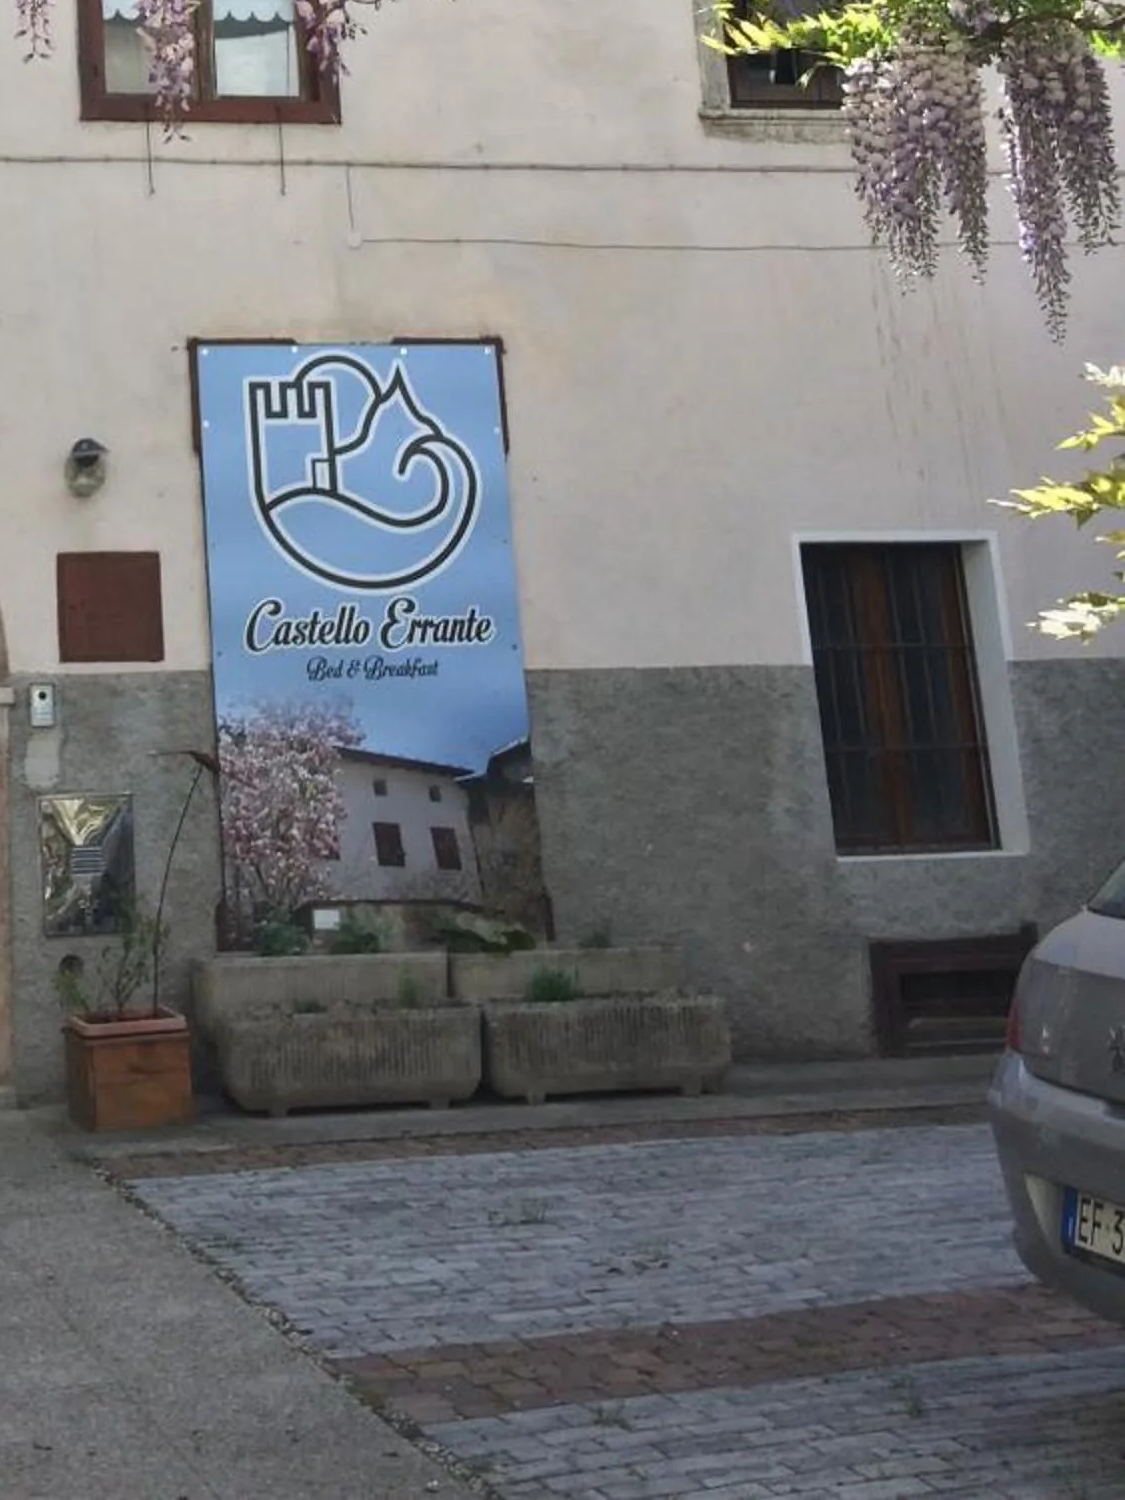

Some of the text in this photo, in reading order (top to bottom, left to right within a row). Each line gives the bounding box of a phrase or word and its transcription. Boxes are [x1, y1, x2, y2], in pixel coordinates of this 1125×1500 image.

[245, 597, 493, 652] Castello Errante
[306, 655, 439, 682] Bed & Breakfast
